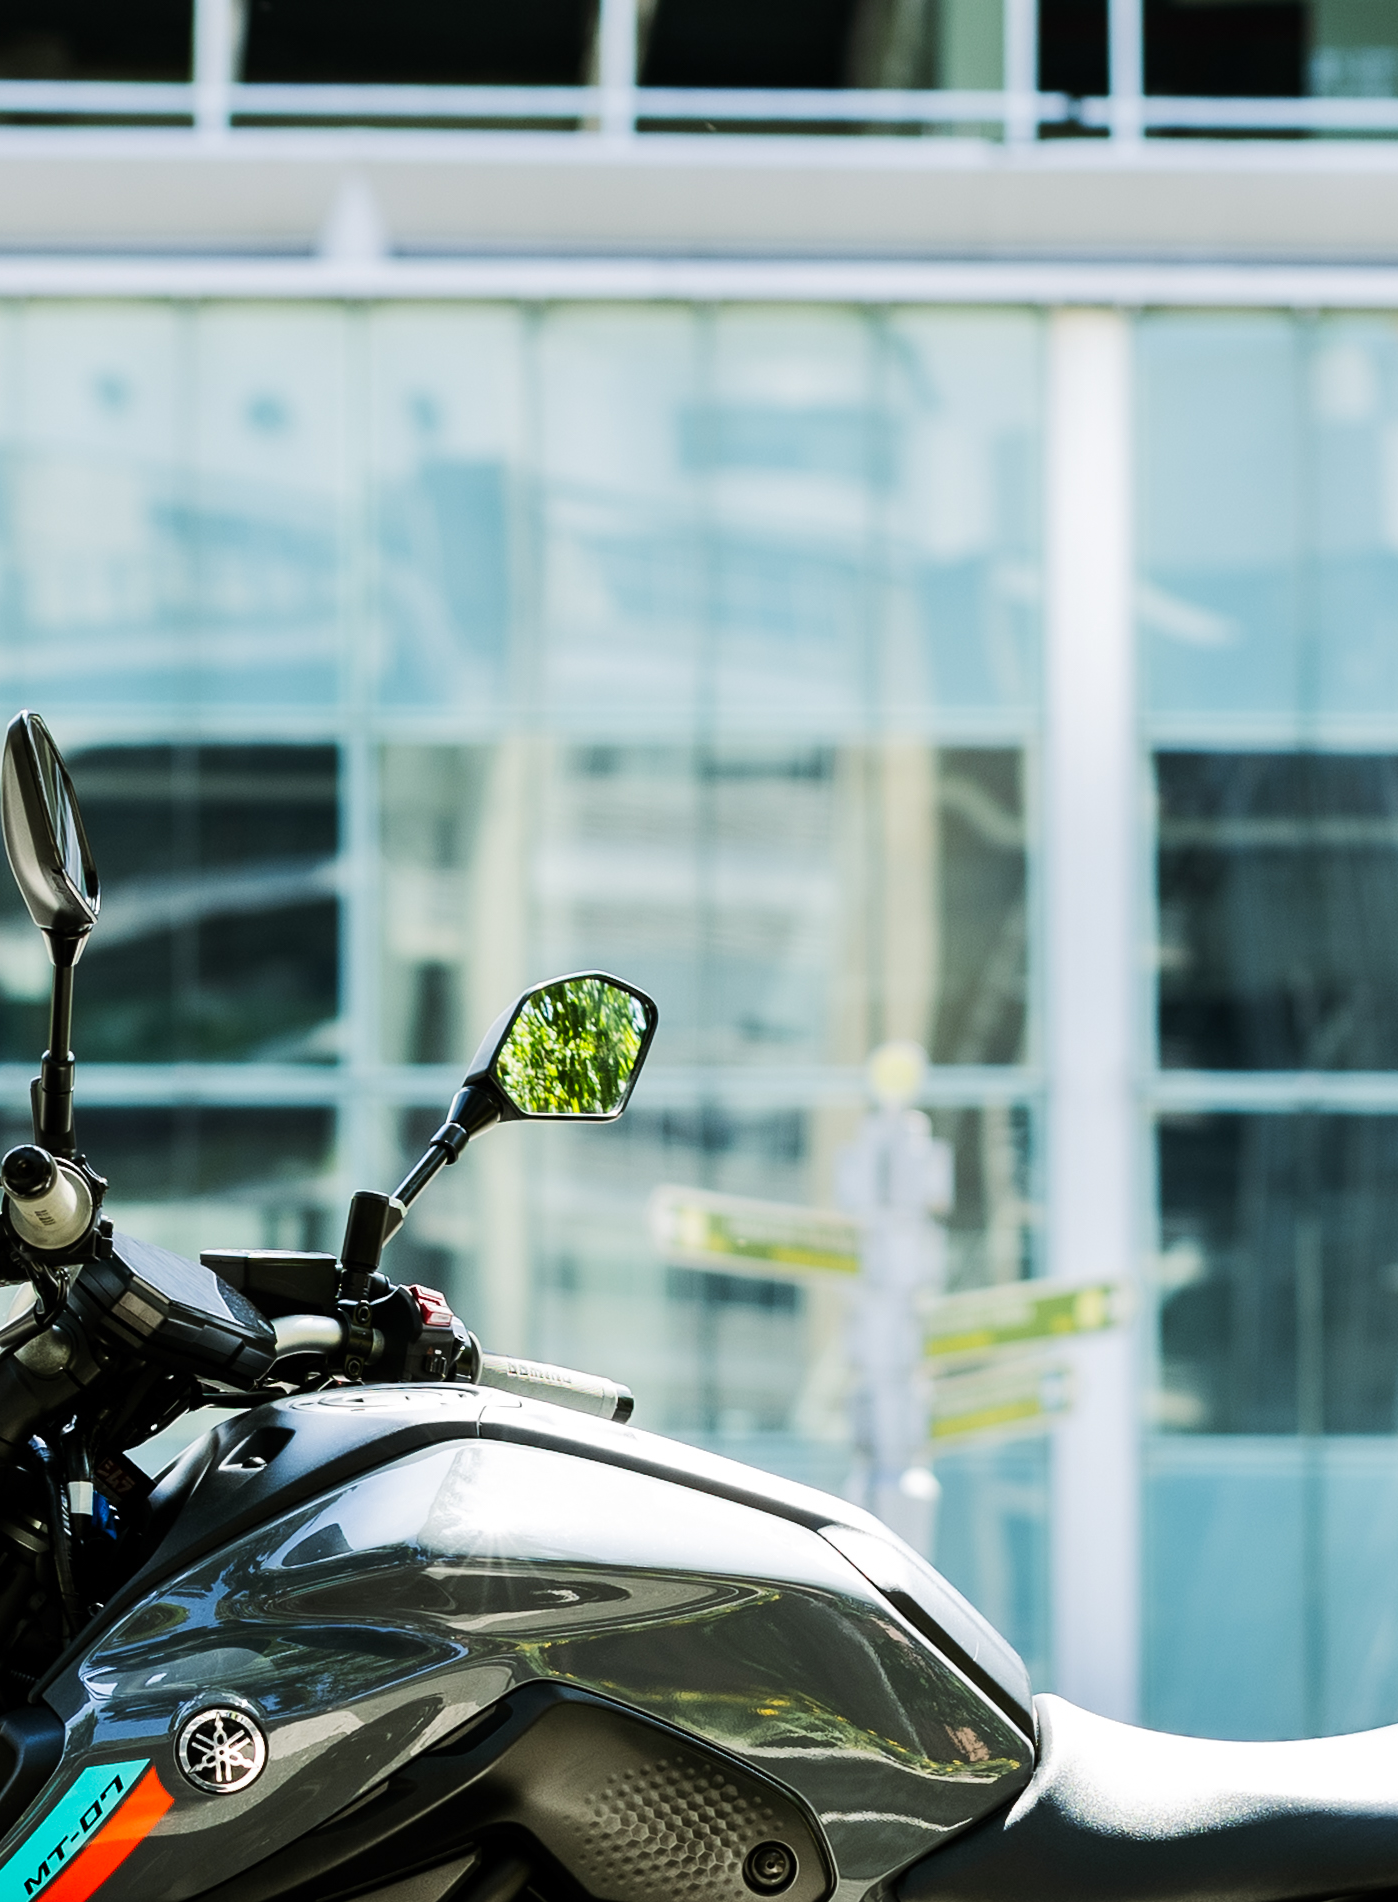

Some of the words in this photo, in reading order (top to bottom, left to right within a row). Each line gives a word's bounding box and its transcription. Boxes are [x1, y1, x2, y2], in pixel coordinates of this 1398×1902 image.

[96, 1457, 136, 1493] シムラ
[23, 1774, 124, 1895] MT-07
